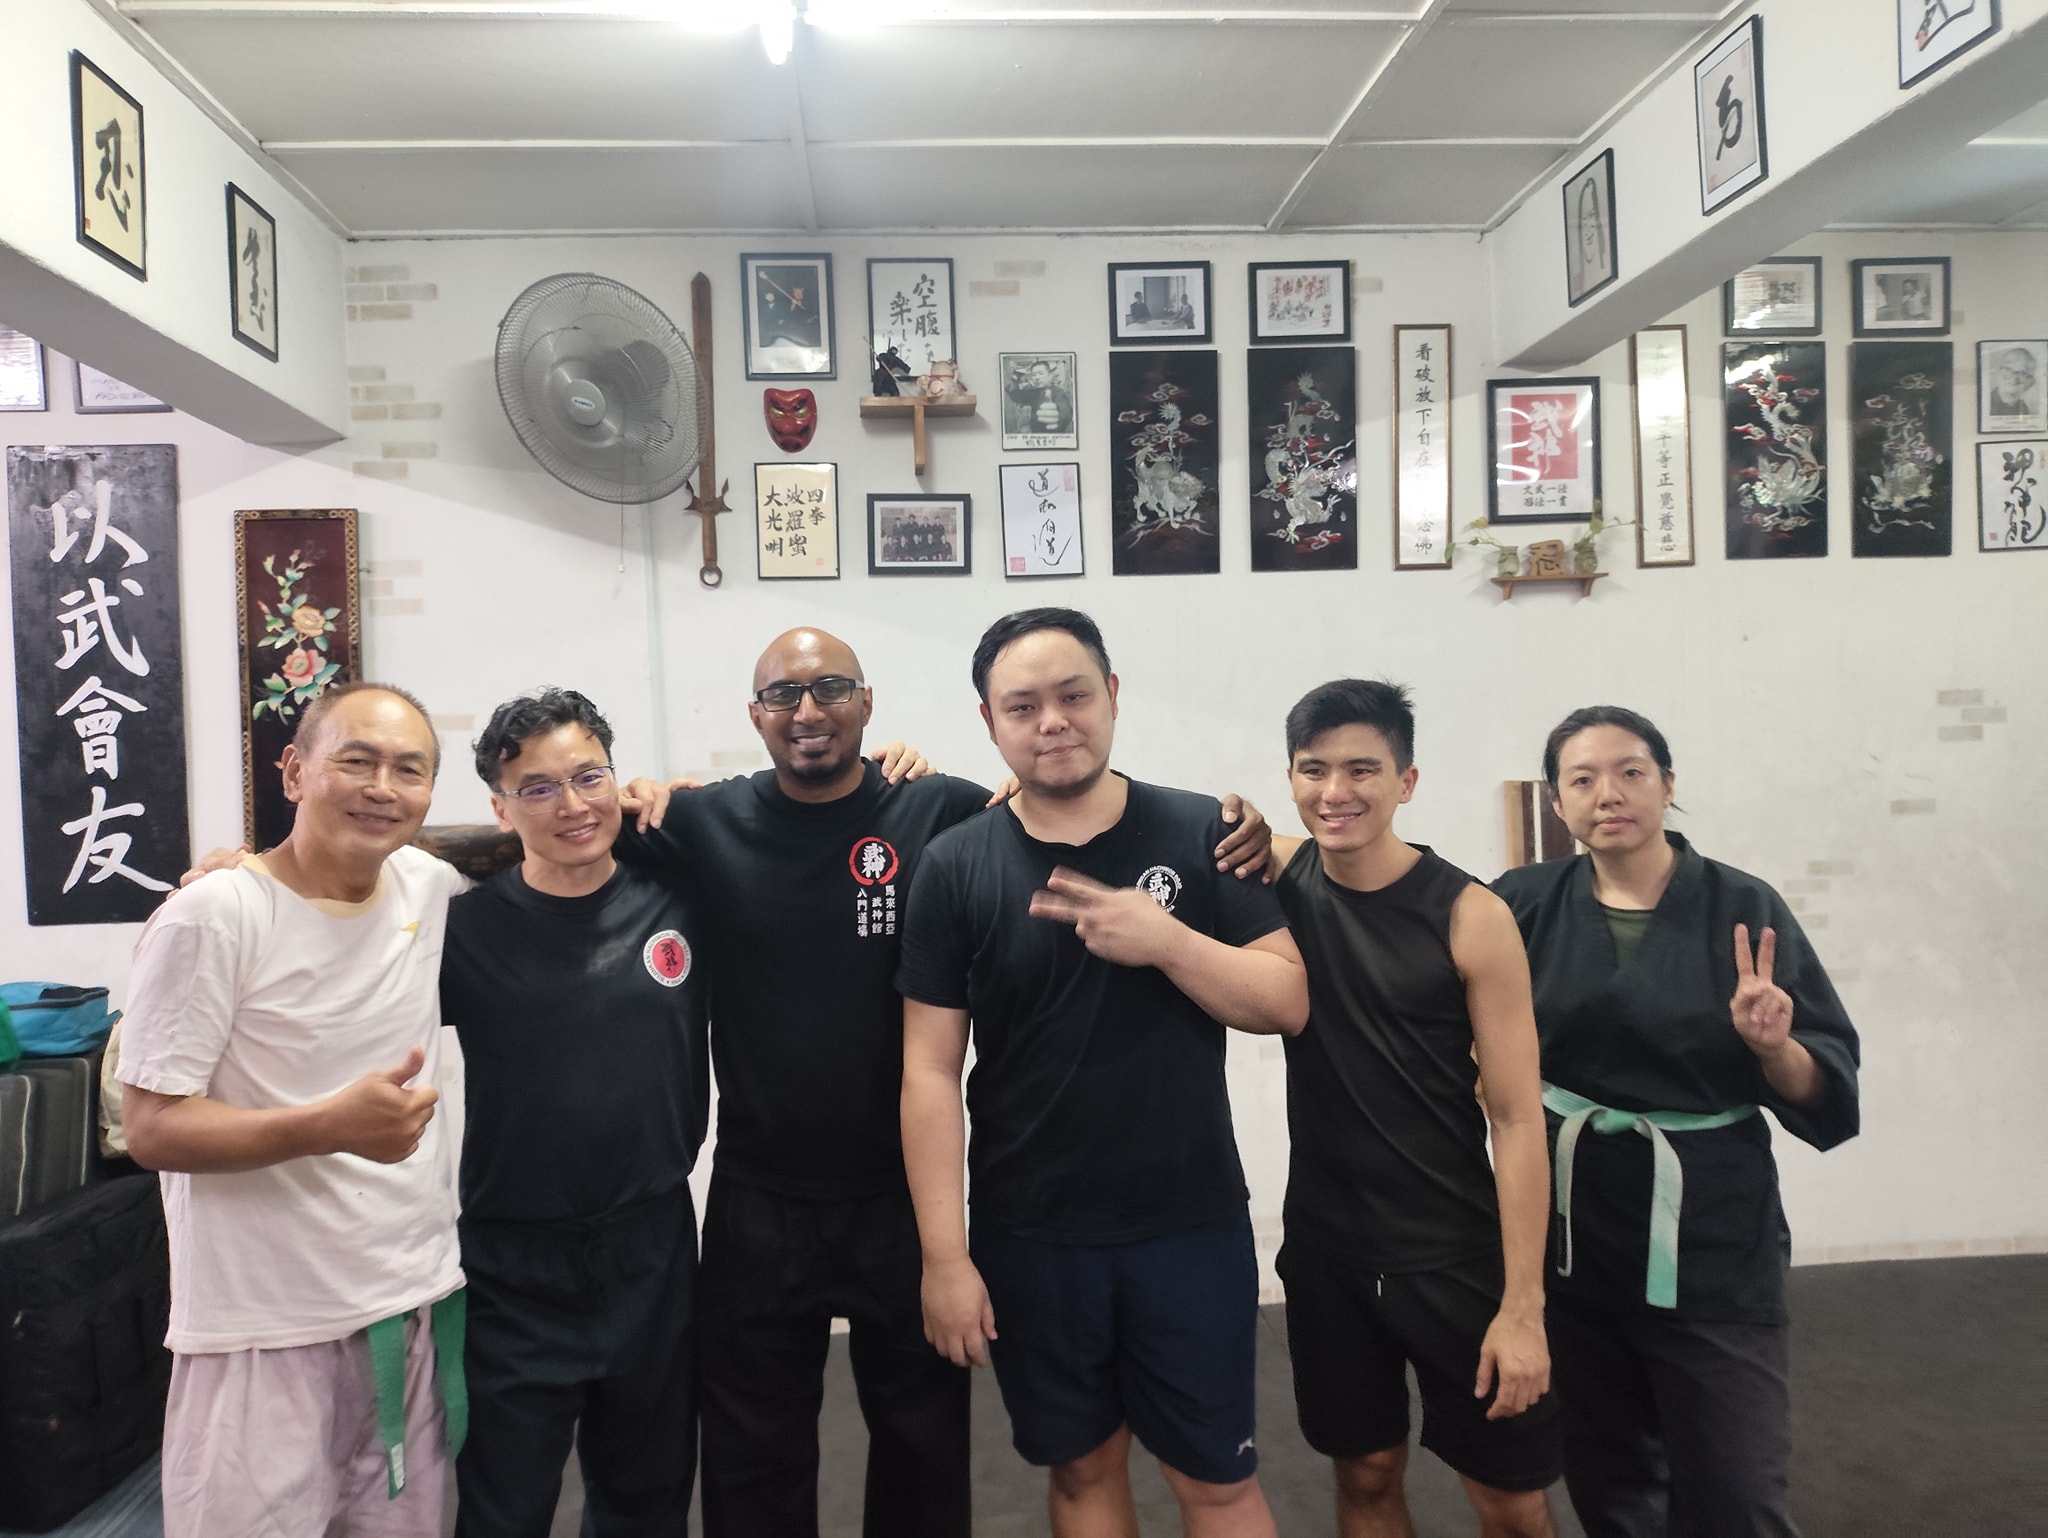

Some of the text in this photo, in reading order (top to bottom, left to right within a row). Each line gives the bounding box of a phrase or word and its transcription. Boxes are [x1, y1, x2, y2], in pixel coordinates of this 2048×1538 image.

[763, 485, 783, 557] 大光明
[50, 479, 176, 894] 以武會友
[861, 842, 887, 879] 武神
[885, 884, 896, 936] 馬來西亞
